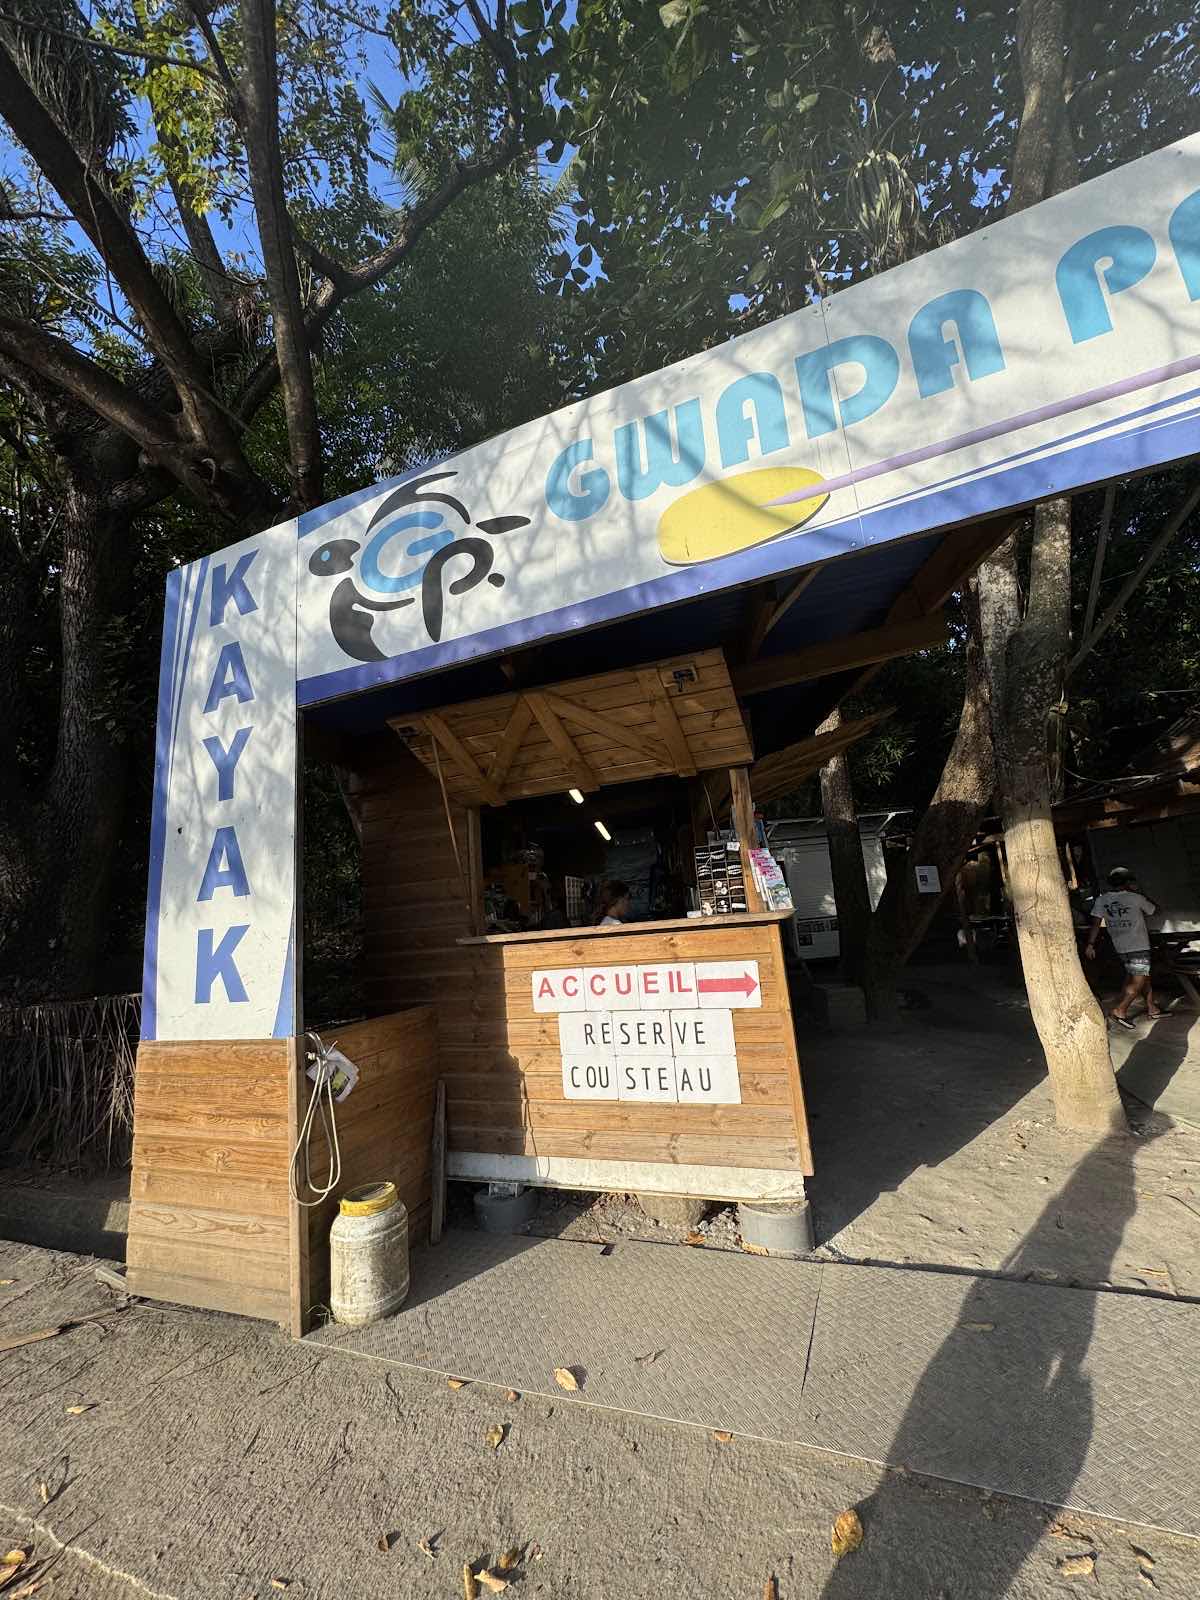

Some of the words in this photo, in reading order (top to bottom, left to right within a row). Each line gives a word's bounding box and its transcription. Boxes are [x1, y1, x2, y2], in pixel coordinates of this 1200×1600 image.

[545, 289, 1006, 521] GWADA
[193, 548, 260, 1005] KAYAK
[538, 970, 693, 998] ACCUEIL
[584, 1021, 706, 1045] RESERVE
